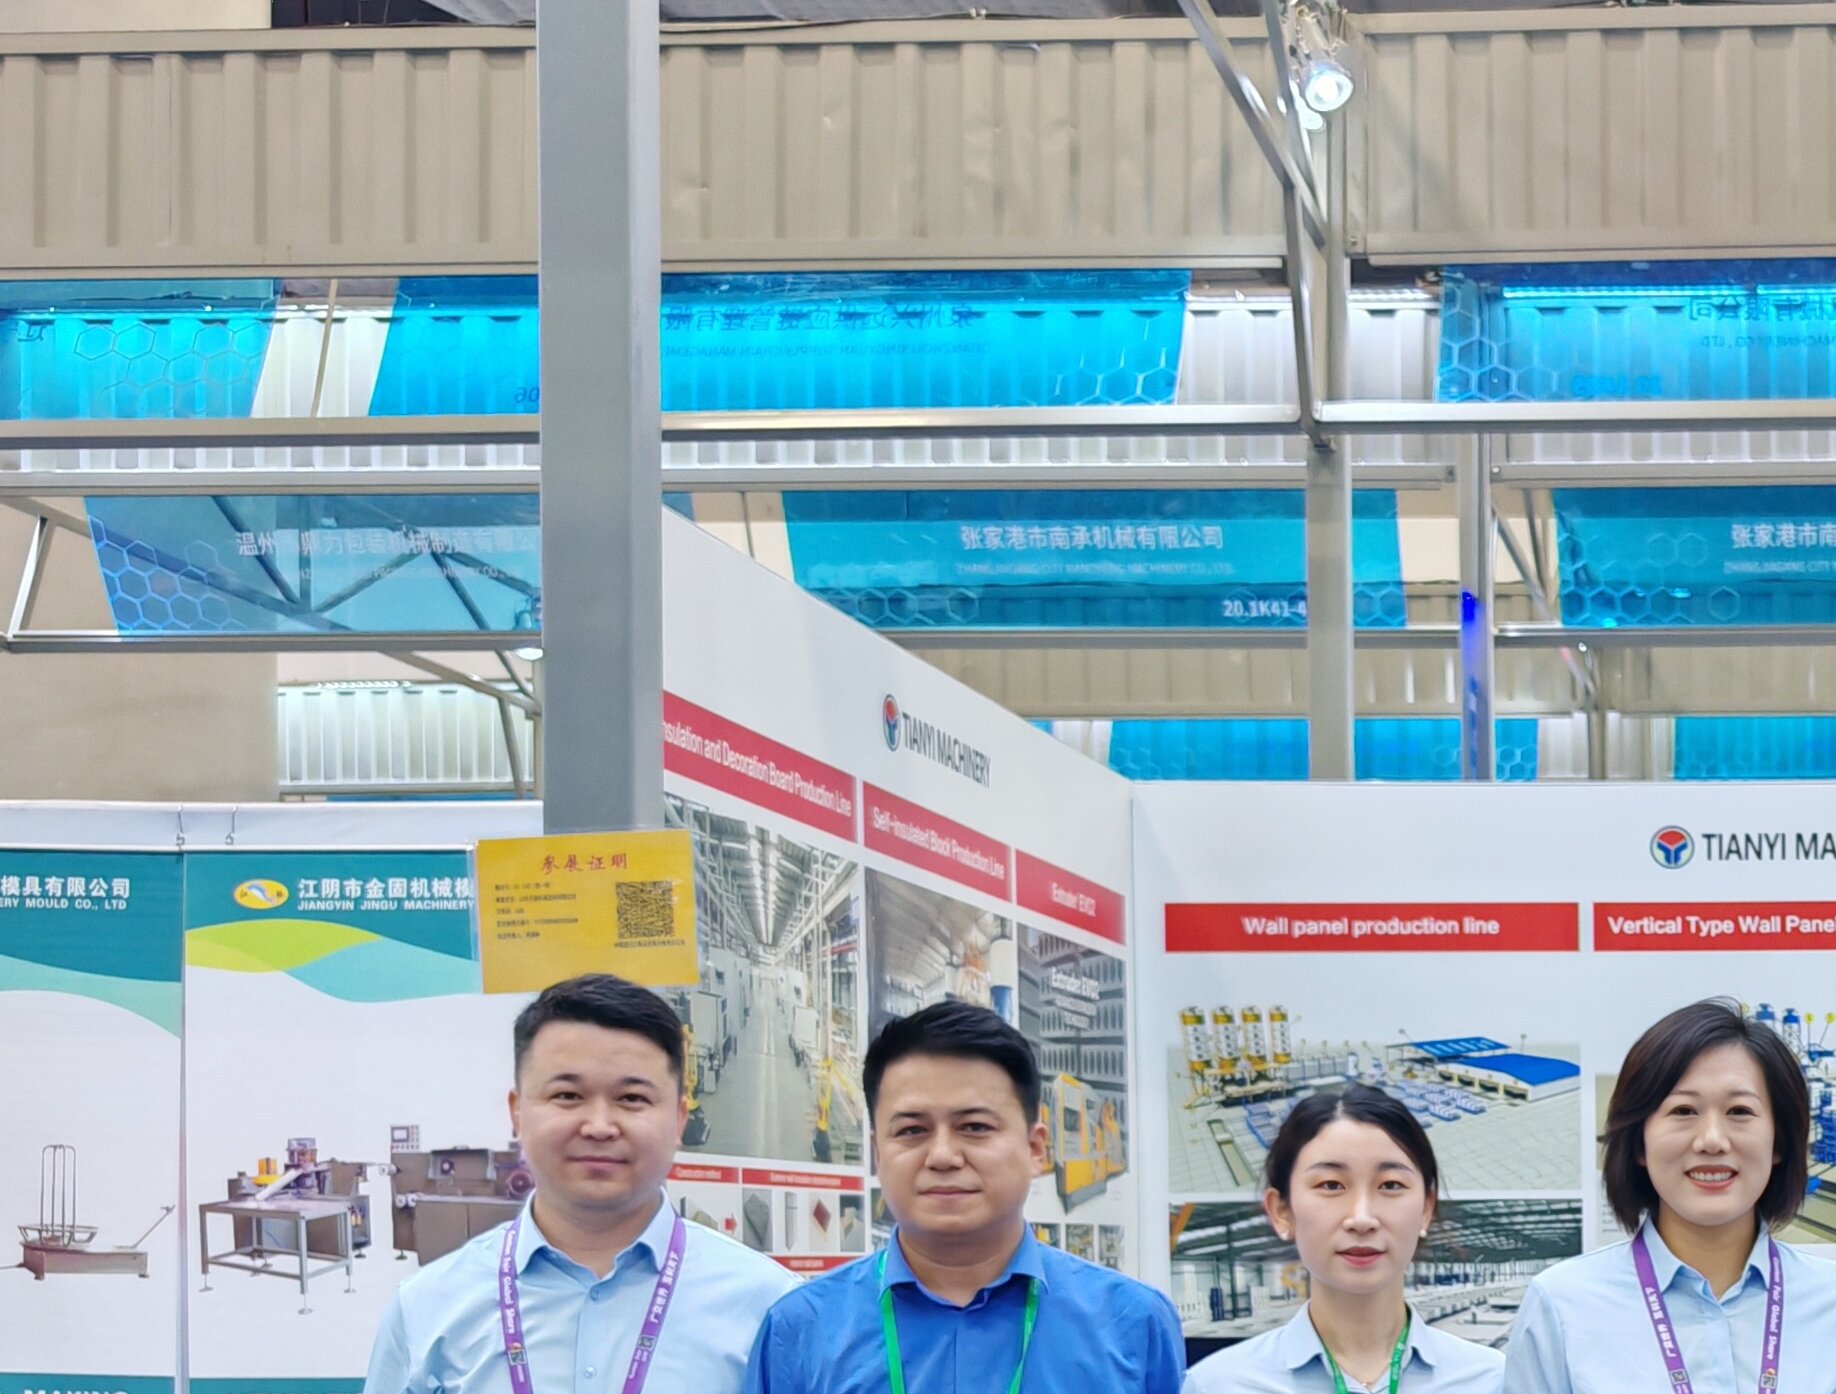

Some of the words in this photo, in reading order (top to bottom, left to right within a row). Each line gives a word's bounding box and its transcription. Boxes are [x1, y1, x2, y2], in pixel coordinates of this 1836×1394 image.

[1222, 600, 1307, 618] 20.1K41-4
[902, 711, 935, 762] TIANYI
[937, 728, 991, 788] MACHINERY
[664, 721, 703, 757] nsulation
[703, 739, 722, 764] and
[722, 740, 769, 782] Decoration
[769, 761, 794, 794] Board
[795, 772, 836, 811] Production
[836, 790, 852, 818] Line
[1701, 833, 1786, 861] TIANYI
[298, 877, 474, 899] 江阴市金固机械模
[25, 898, 69, 910] MOULD
[105, 899, 127, 910] LTD
[298, 900, 355, 911] JIANGYIN
[360, 900, 398, 911] JINGU
[404, 900, 474, 910] MACHINERY
[1242, 917, 1288, 935] Wall
[1293, 917, 1348, 938] panel
[1353, 917, 1457, 938] production
[1463, 916, 1500, 935] line
[1607, 916, 1682, 935] Vertical
[1686, 916, 1734, 937] Type
[1738, 916, 1780, 933] Wall
[1768, 1304, 1780, 1333] Global
[1766, 1335, 1777, 1360] Share
